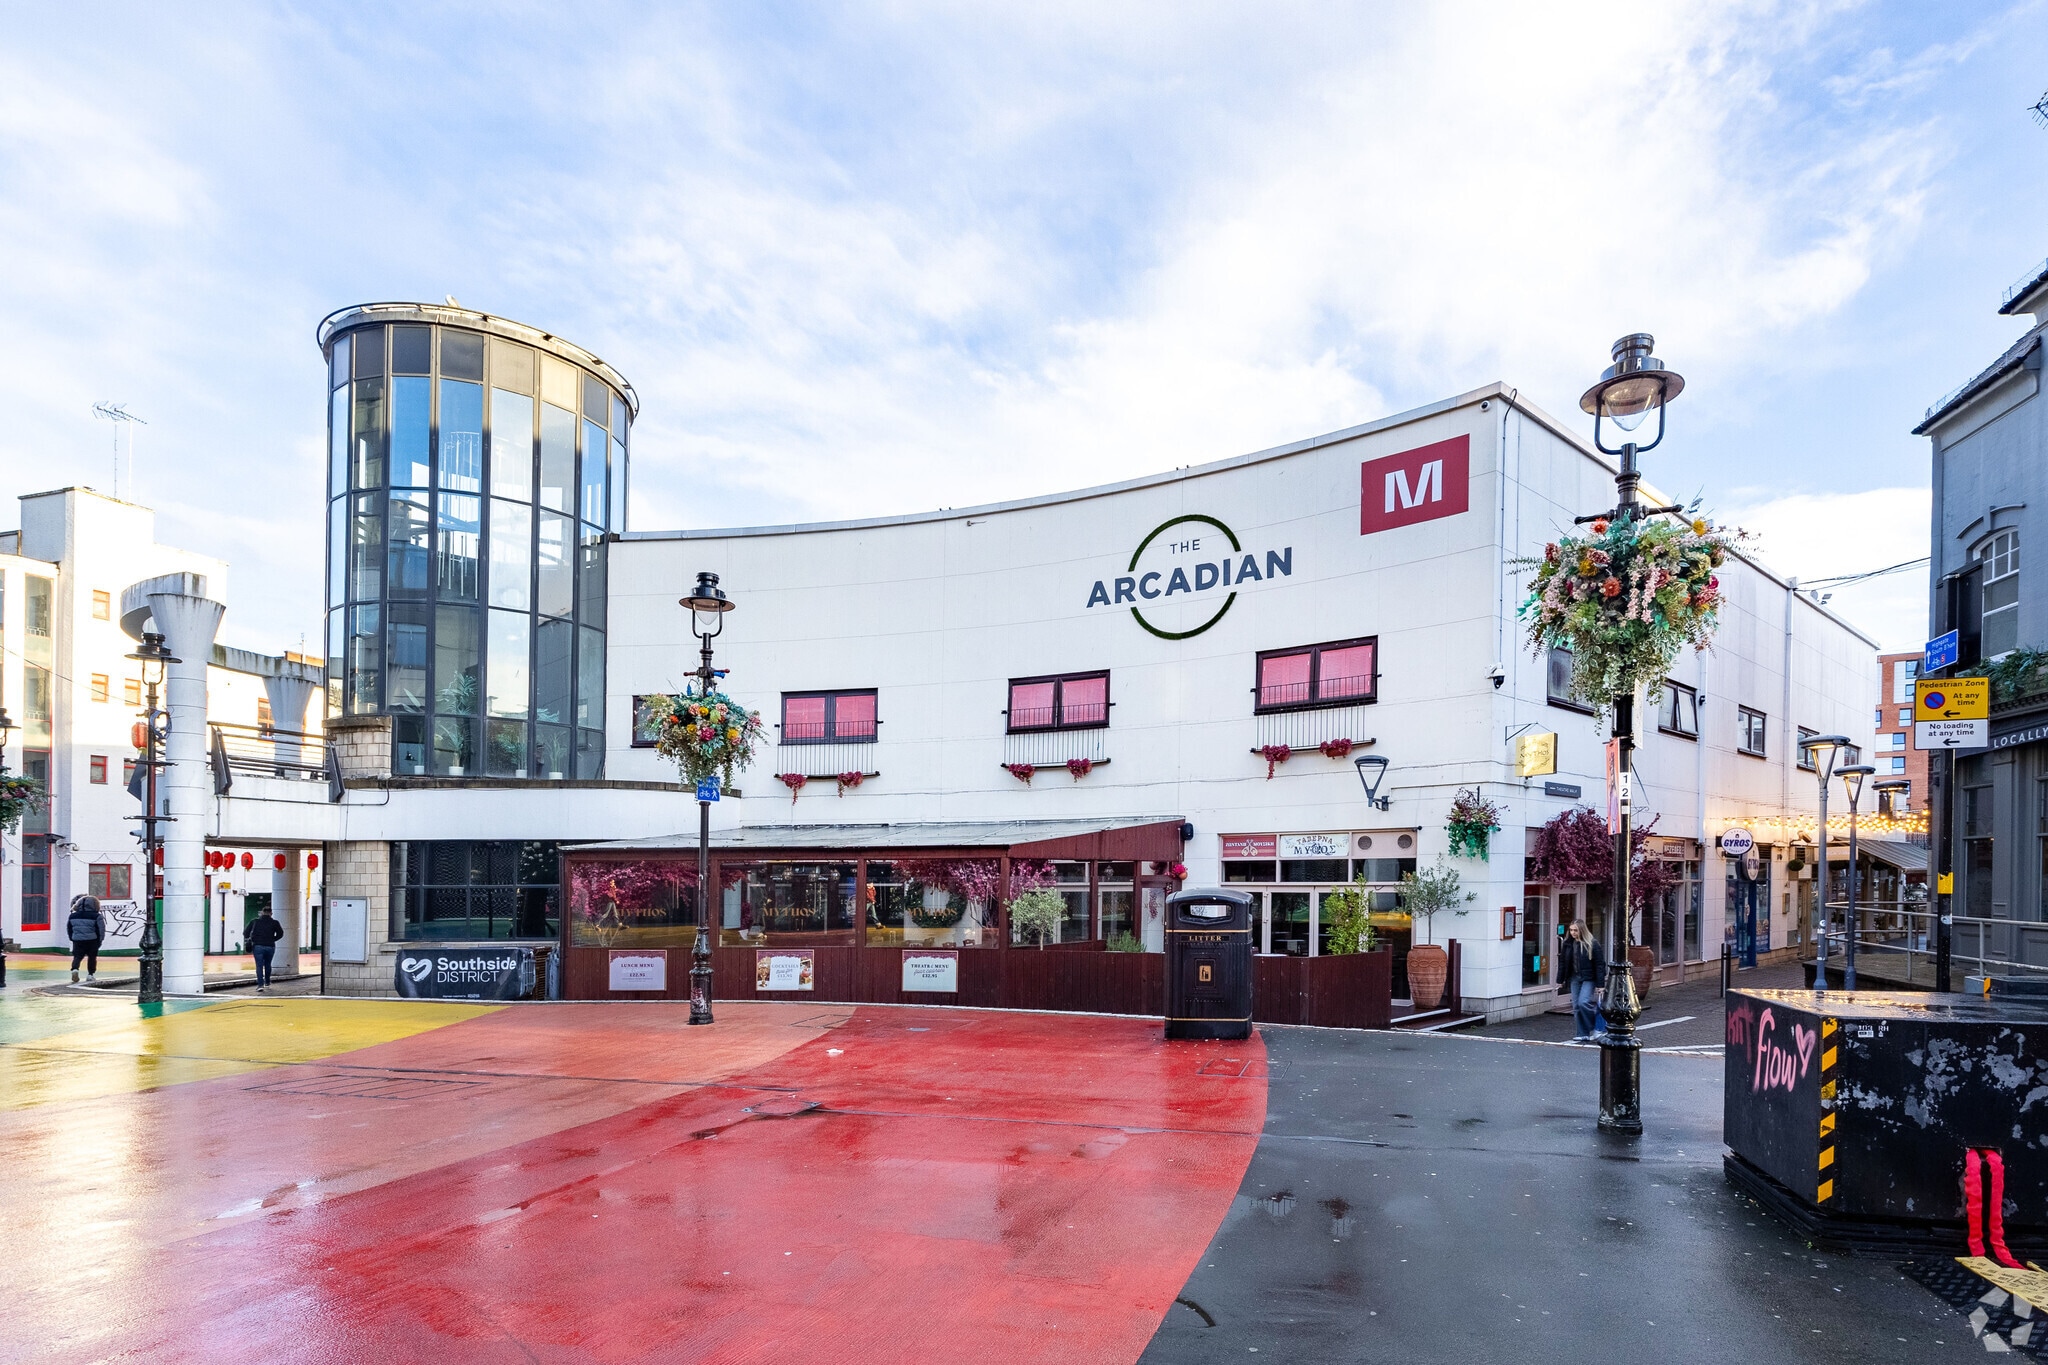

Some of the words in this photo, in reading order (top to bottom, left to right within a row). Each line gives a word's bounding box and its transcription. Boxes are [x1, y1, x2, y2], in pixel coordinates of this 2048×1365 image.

[1385, 459, 1443, 513] M
[1170, 539, 1201, 554] THE
[1086, 547, 1292, 608] ARCADIAN
[1931, 638, 1949, 648] Highgate
[1931, 647, 1943, 655] South
[1965, 692, 1980, 700] any
[1943, 722, 1974, 730] loading
[1993, 727, 2048, 749] LOCALLY
[1623, 774, 1629, 783] 1
[1621, 788, 1629, 797] 2
[1723, 839, 1750, 847] GYROS
[437, 957, 517, 970] Southside
[437, 970, 499, 982] DISTRICT
